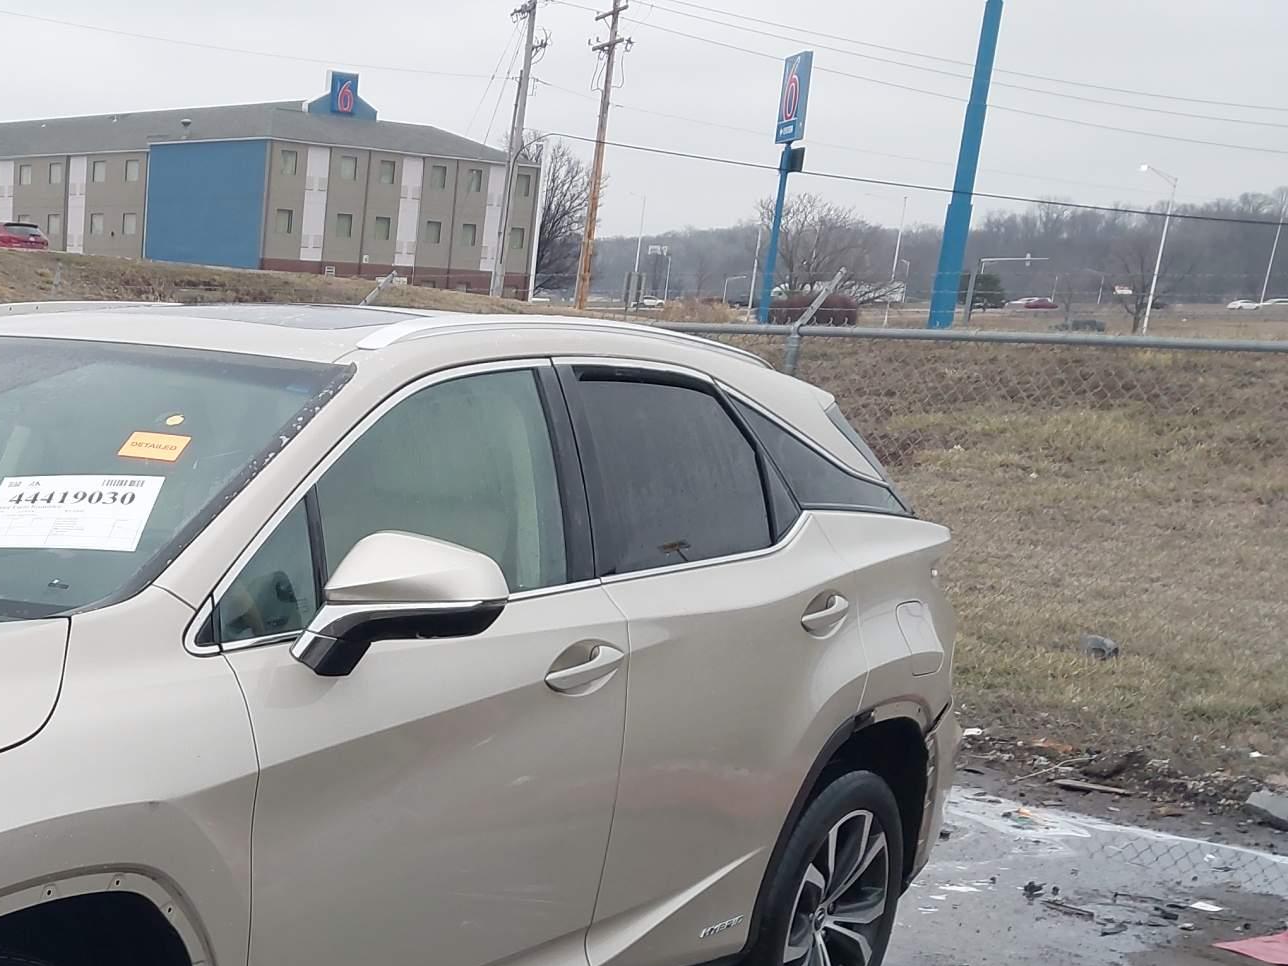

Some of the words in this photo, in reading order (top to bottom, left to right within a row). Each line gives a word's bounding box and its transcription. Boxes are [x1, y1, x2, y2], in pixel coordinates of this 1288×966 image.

[338, 80, 354, 112] 6
[783, 56, 800, 121] 6
[130, 441, 178, 451] DETAILED
[8, 490, 136, 505] 44419030
